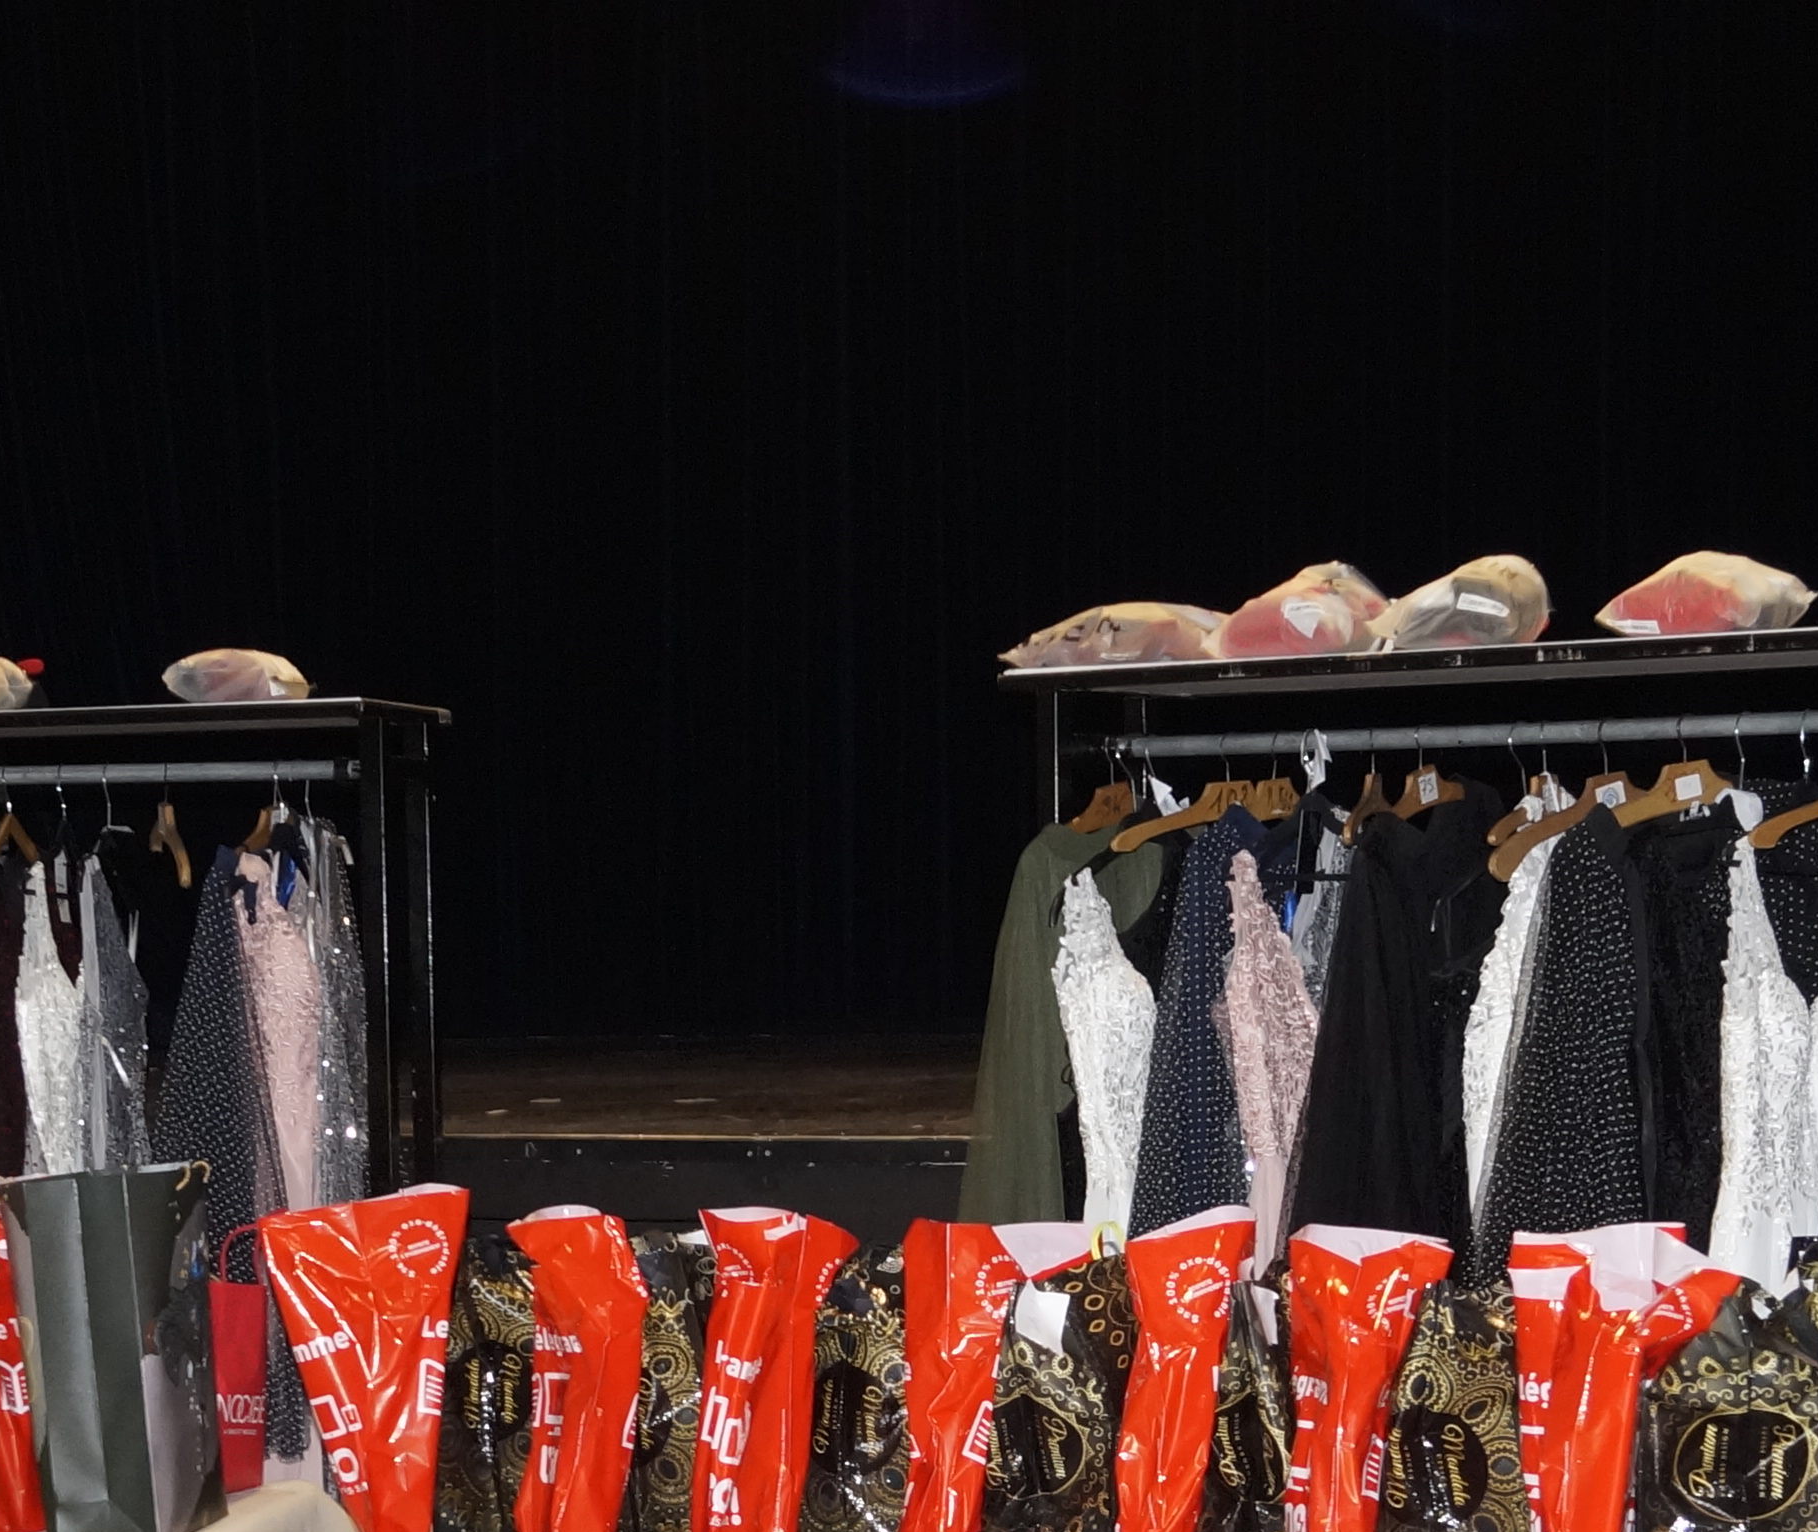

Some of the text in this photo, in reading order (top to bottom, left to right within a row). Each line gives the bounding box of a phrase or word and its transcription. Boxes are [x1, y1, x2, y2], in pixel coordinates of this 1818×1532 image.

[421, 1315, 450, 1339] Le
[812, 1379, 834, 1454] Mandala
[1042, 1415, 1068, 1480] Premium
[1215, 1416, 1246, 1487] Premium
[1386, 1428, 1408, 1509] Mandala
[1441, 1424, 1471, 1507] Mandala
[1689, 1423, 1718, 1499] Premium
[1771, 1424, 1797, 1501] Premium
